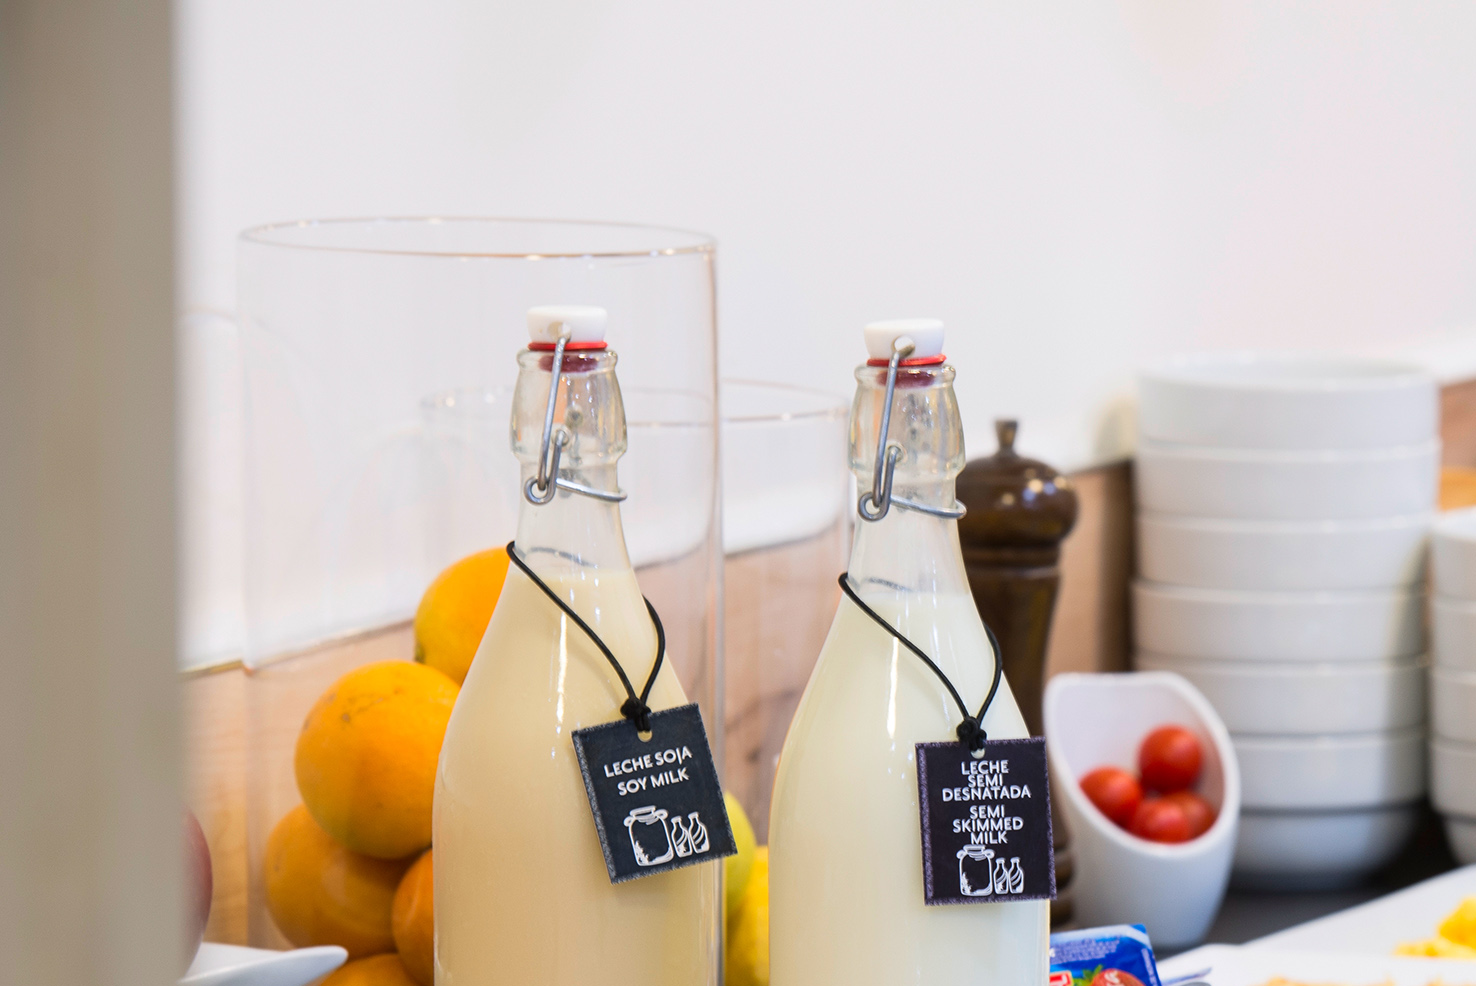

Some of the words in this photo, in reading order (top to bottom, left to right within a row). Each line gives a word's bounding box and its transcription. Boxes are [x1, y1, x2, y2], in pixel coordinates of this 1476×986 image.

[603, 755, 653, 778] LECHE
[656, 746, 693, 766] SOJA
[961, 760, 1009, 775] LECHE
[617, 776, 648, 796] SOY
[650, 767, 690, 789] MILK
[968, 774, 1003, 788] SEMI
[942, 785, 1031, 802] DESNATADA
[969, 805, 1005, 819] SEMI
[952, 817, 1024, 833] SKIMMED
[970, 831, 1008, 845] MILK
